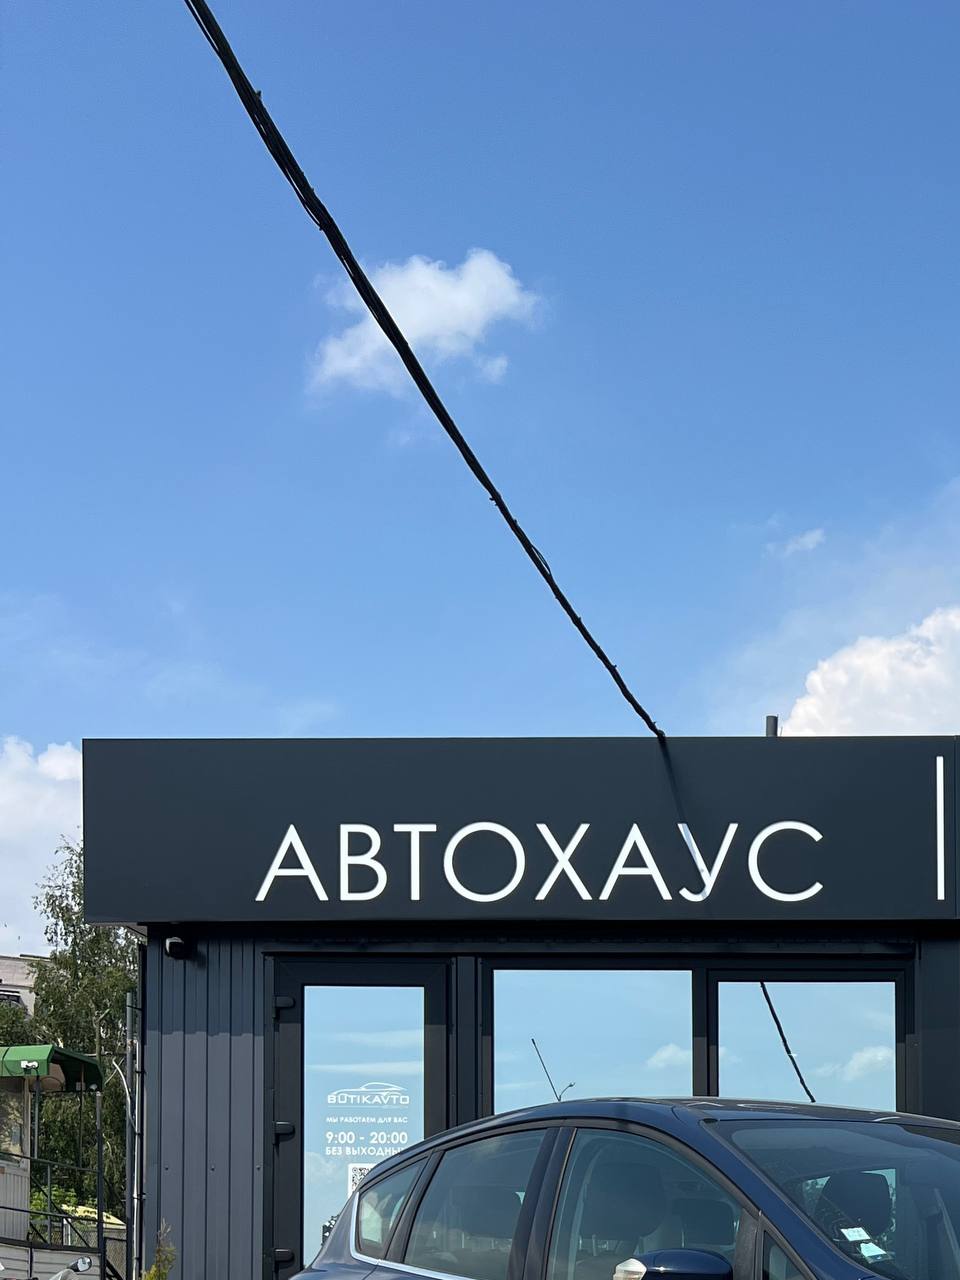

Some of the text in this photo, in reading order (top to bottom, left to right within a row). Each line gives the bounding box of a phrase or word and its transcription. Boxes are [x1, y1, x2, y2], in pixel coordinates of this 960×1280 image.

[254, 821, 823, 902] АВТОХАУС
[327, 1094, 410, 1105] BUTIKAVTO
[325, 1131, 355, 1144] 9:00
[369, 1131, 408, 1144] 20:00
[325, 1146, 406, 1157] БЕЗ ВЫХОДНЫ
